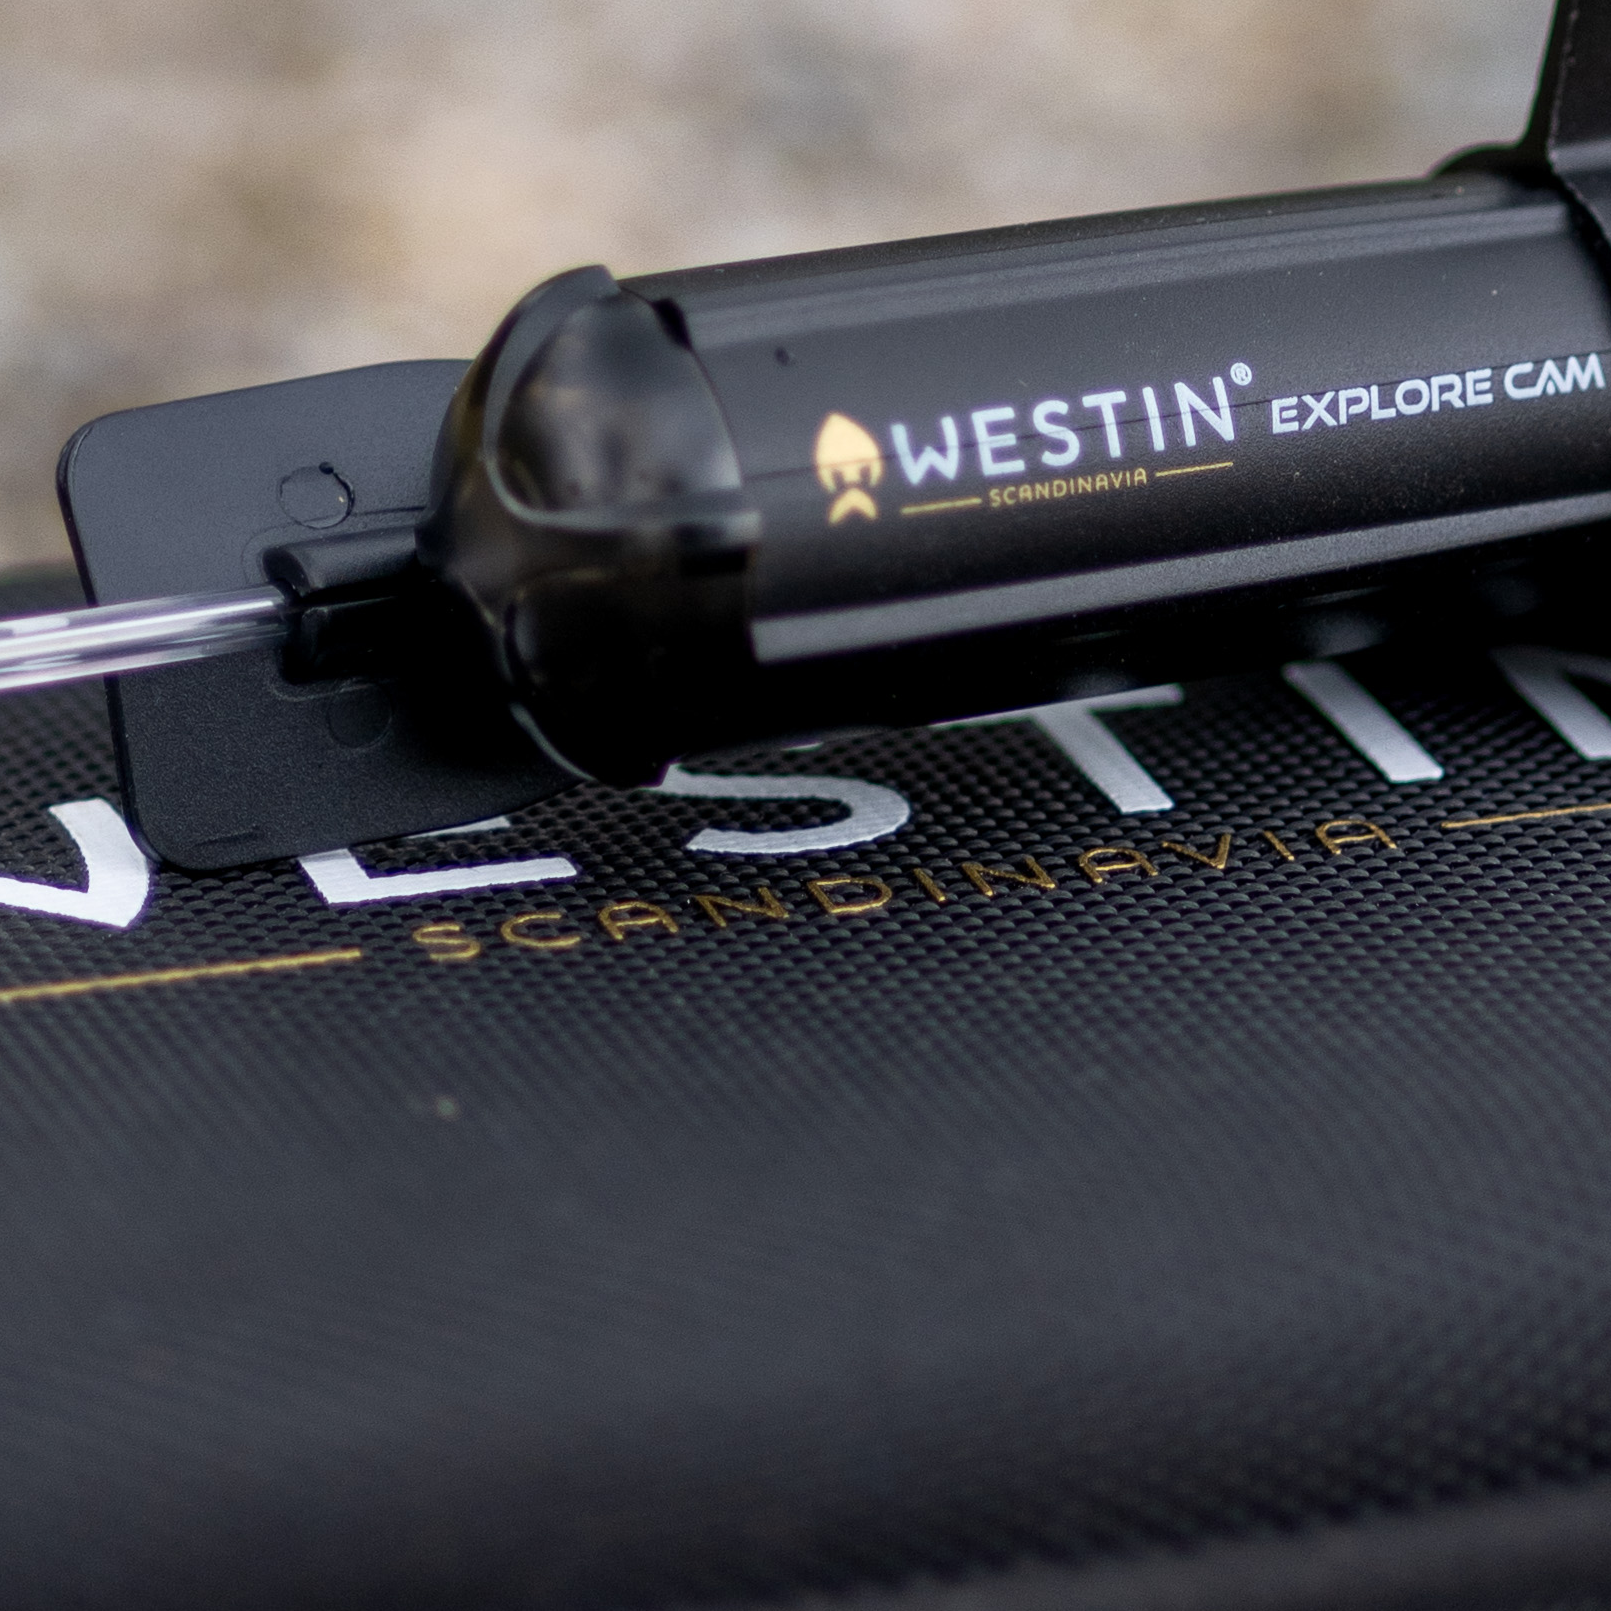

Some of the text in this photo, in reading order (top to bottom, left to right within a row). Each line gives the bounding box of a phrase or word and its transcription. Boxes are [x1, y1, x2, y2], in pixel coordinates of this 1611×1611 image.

[1270, 370, 1494, 434] EXPLORE
[1502, 352, 1606, 402] CAM
[989, 467, 1148, 508] SCANDINAVIA
[412, 819, 1398, 960] SCANDINAVIA
